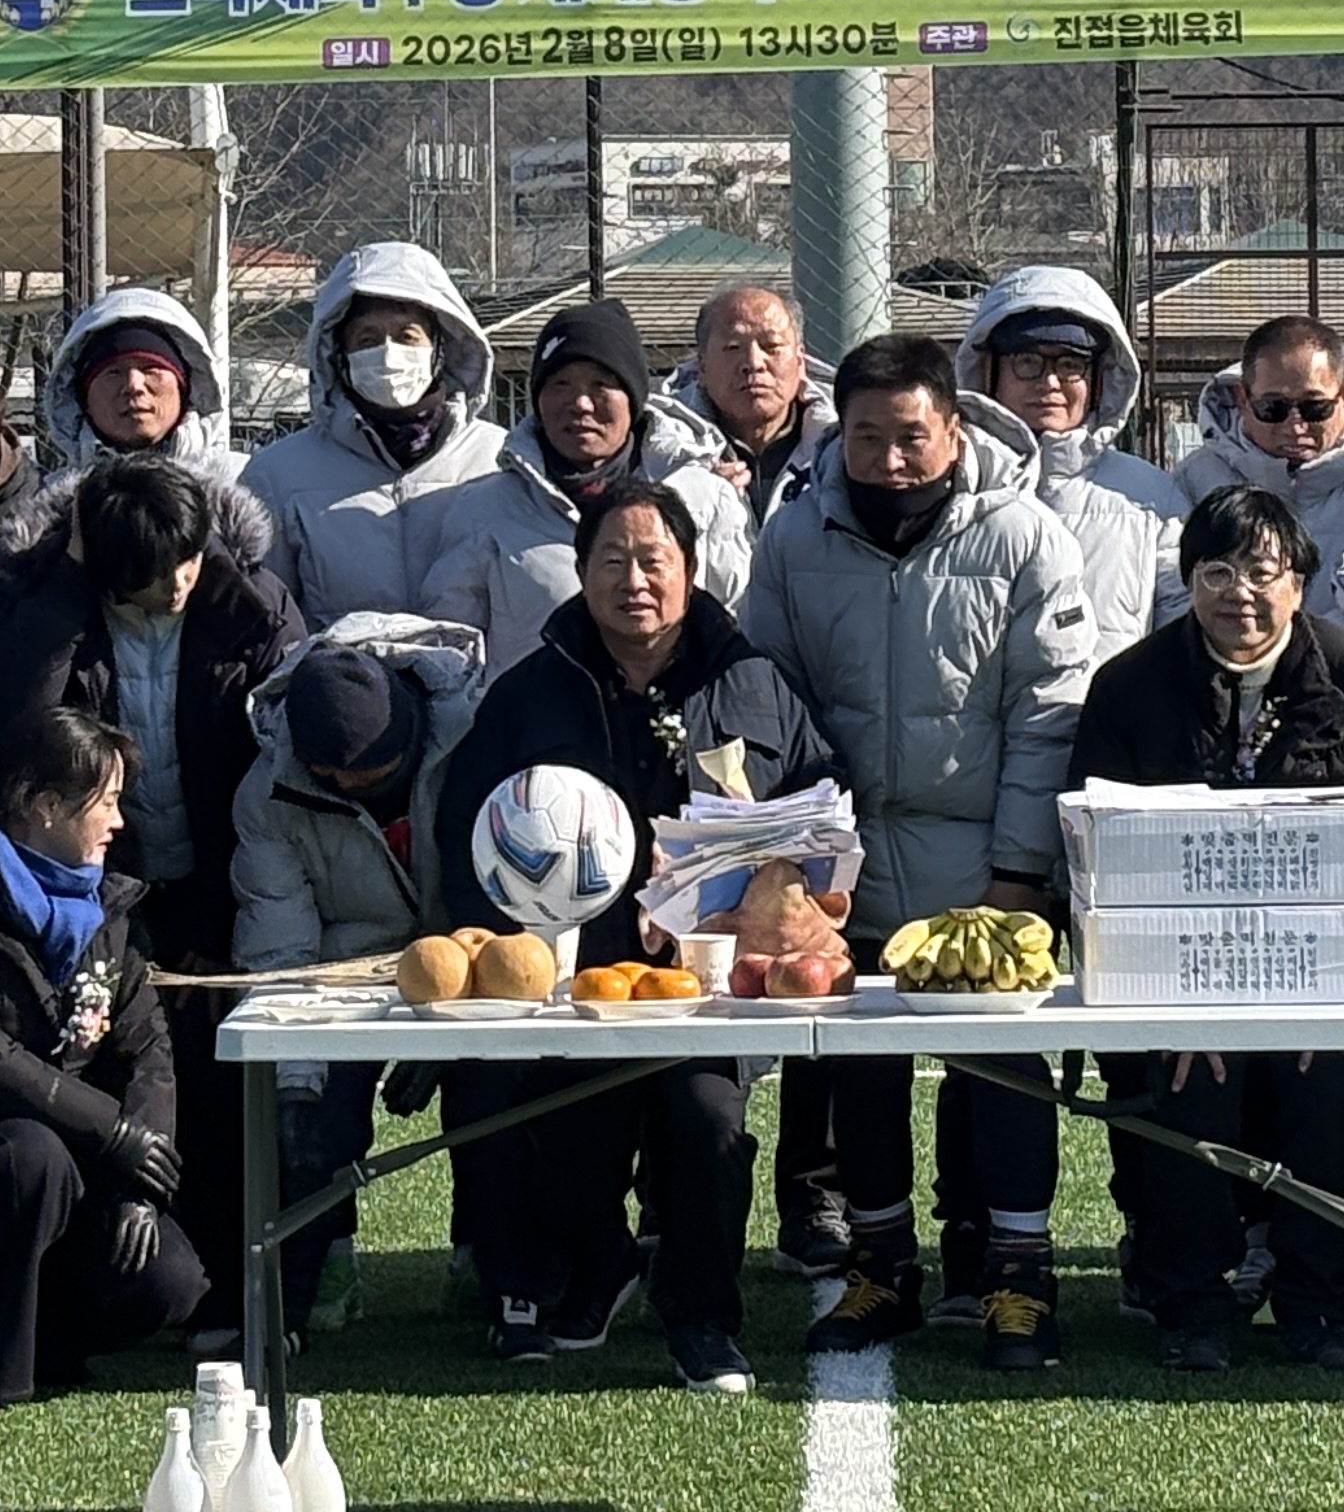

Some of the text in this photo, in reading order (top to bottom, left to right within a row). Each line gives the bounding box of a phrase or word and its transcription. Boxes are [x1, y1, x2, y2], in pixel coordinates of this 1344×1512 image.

[330, 40, 381, 67] 일시
[401, 31, 534, 67] 2026년
[541, 27, 596, 66] 2월
[605, 24, 722, 64] 8일(일)
[739, 21, 900, 58] 13시30분
[925, 24, 978, 50] 주관
